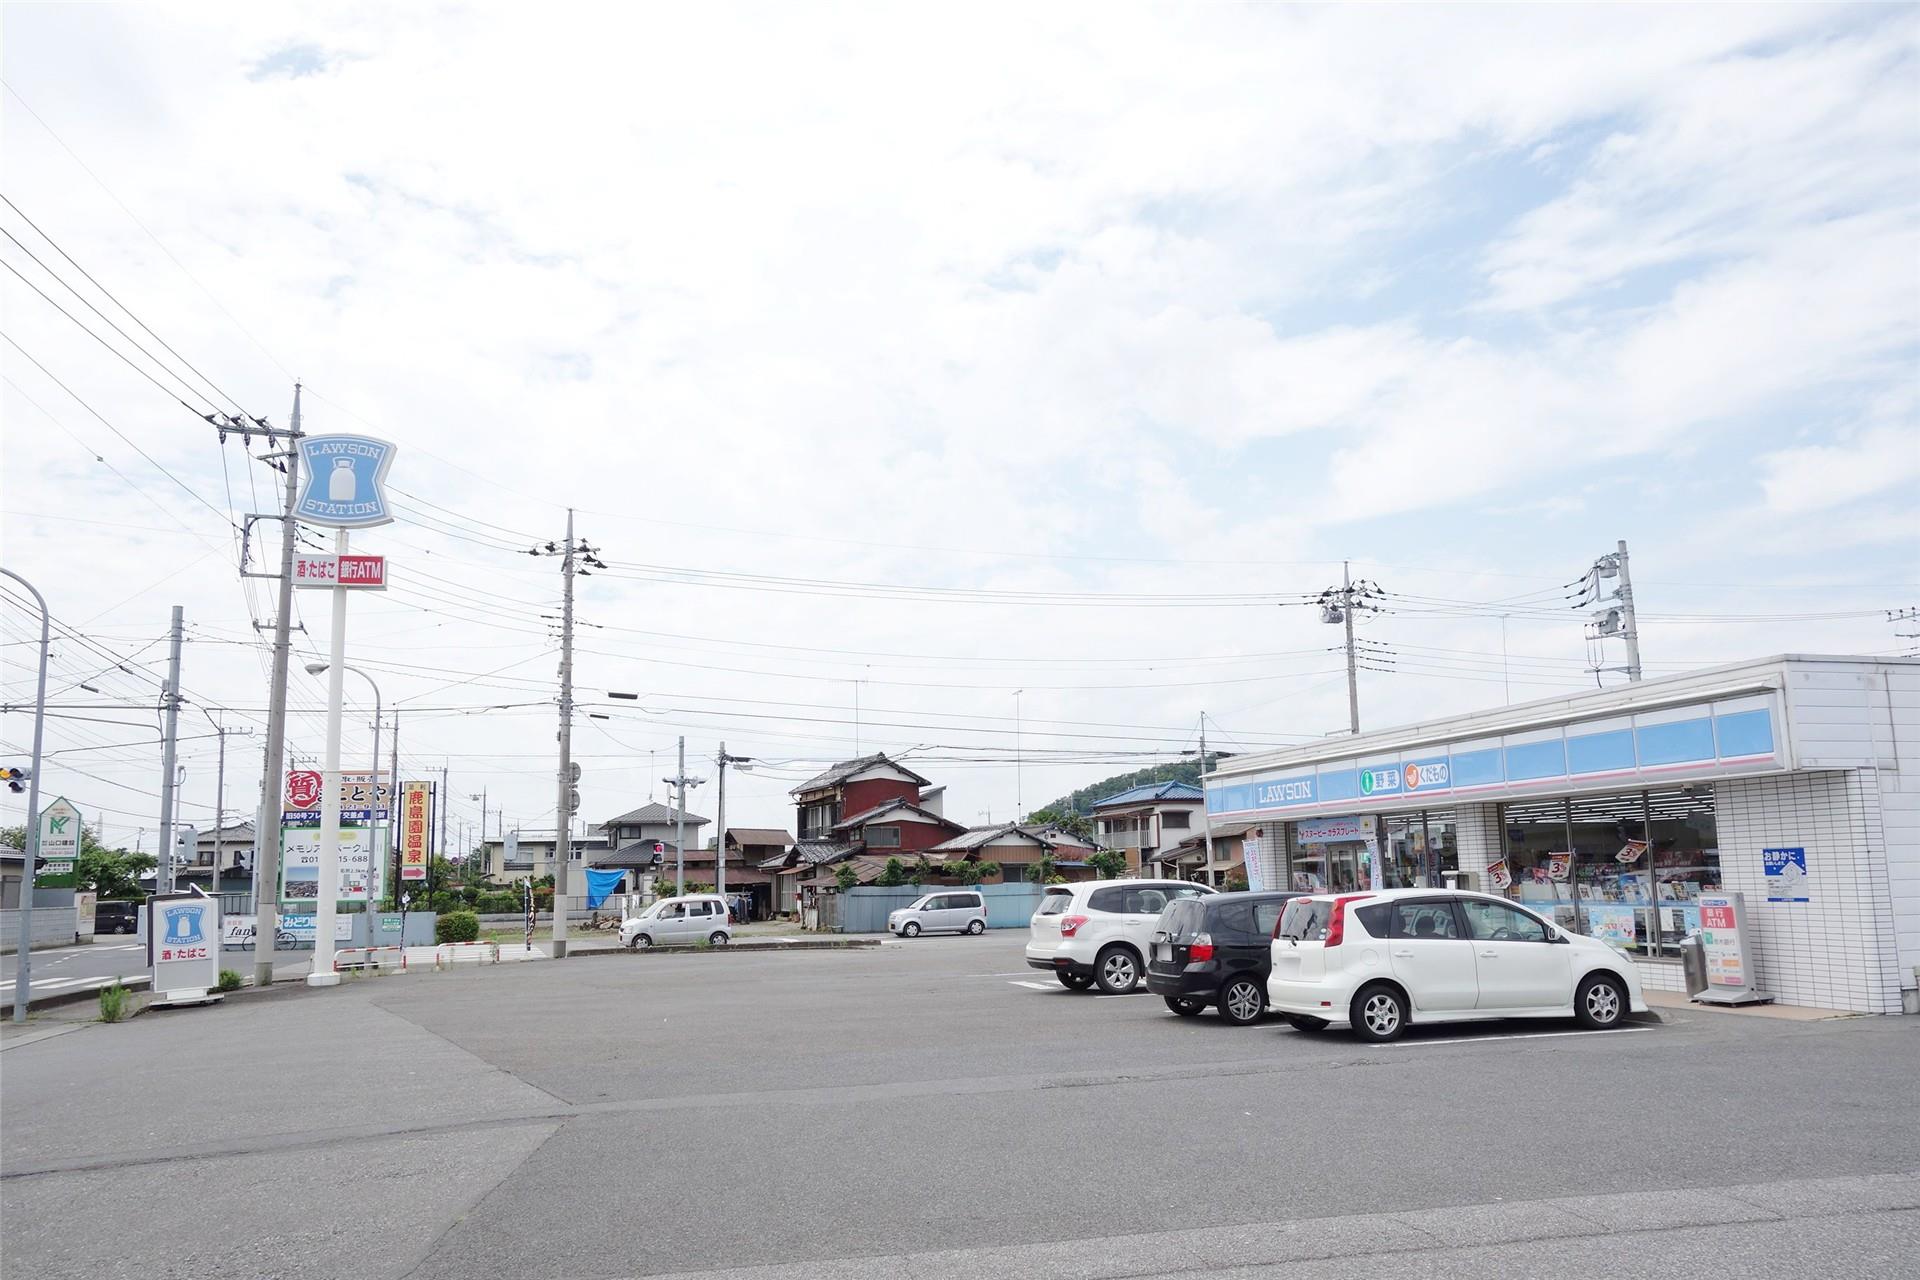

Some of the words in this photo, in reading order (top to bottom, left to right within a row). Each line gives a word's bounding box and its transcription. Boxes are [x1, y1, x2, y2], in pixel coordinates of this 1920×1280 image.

[308, 443, 380, 460] LAWSON
[305, 499, 378, 515] STATION
[340, 560, 381, 579] 銀行ATM
[1375, 771, 1398, 788] 野菜
[1418, 767, 1448, 783] くだもの
[1258, 781, 1312, 804] LAWSON
[408, 791, 424, 863] 鹿島園温泉
[166, 907, 202, 917] LAWSON
[1706, 918, 1727, 928] ATM
[166, 935, 201, 944] STATION
